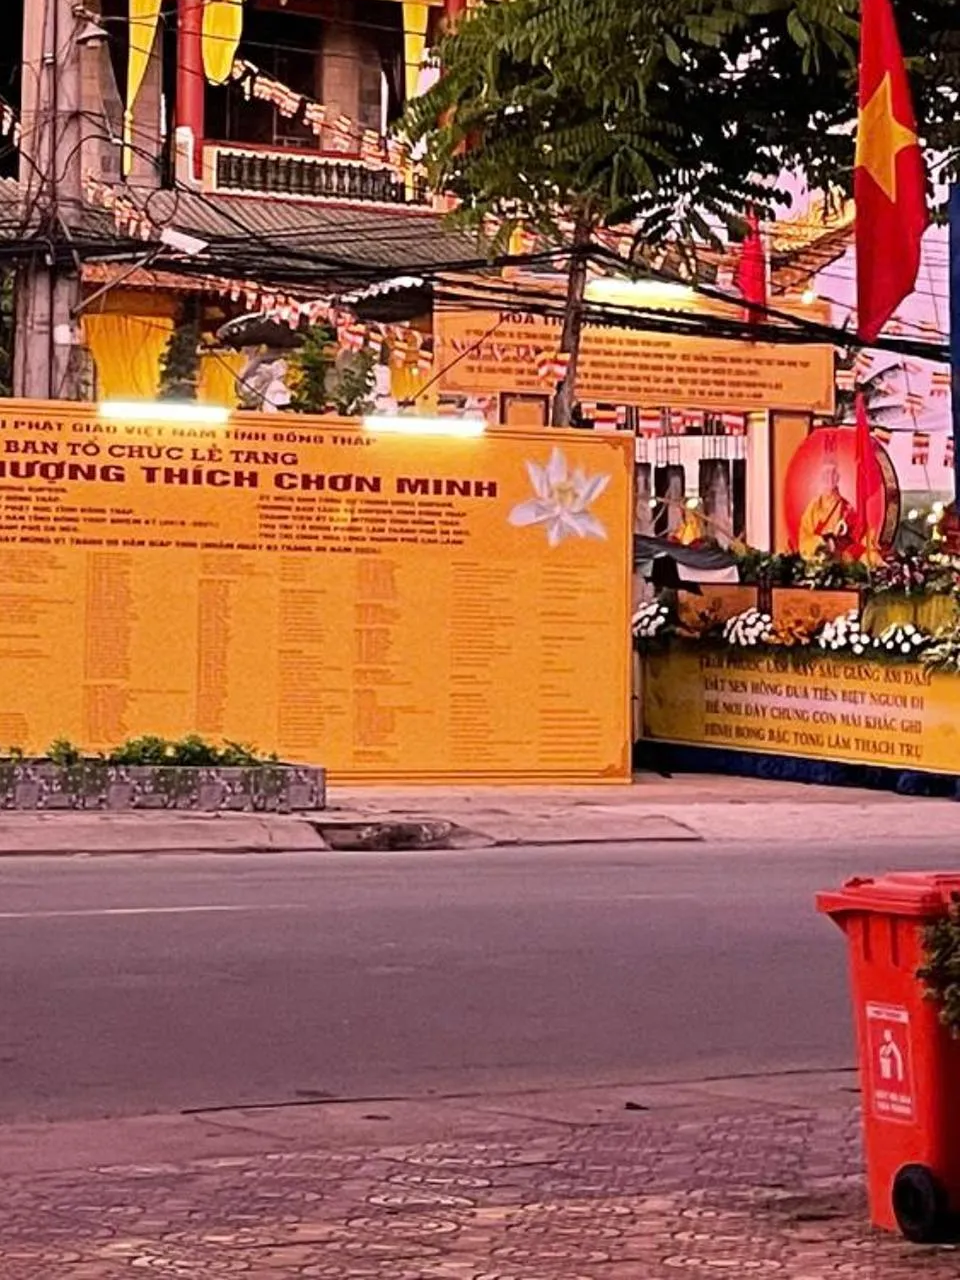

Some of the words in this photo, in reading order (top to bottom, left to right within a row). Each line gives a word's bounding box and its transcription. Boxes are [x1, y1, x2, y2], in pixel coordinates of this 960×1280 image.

[13, 418, 65, 432] PHẬT
[71, 421, 118, 435] GIÁO
[124, 423, 164, 438] VIỆT
[171, 426, 218, 439] NAM
[3, 439, 59, 455] BAN
[67, 435, 101, 456] TỔ
[107, 441, 184, 460] CHỨC
[229, 449, 299, 466] TANG
[140, 463, 259, 488] THÍCH
[273, 472, 382, 493] CHƠN
[395, 476, 498, 498] MINH
